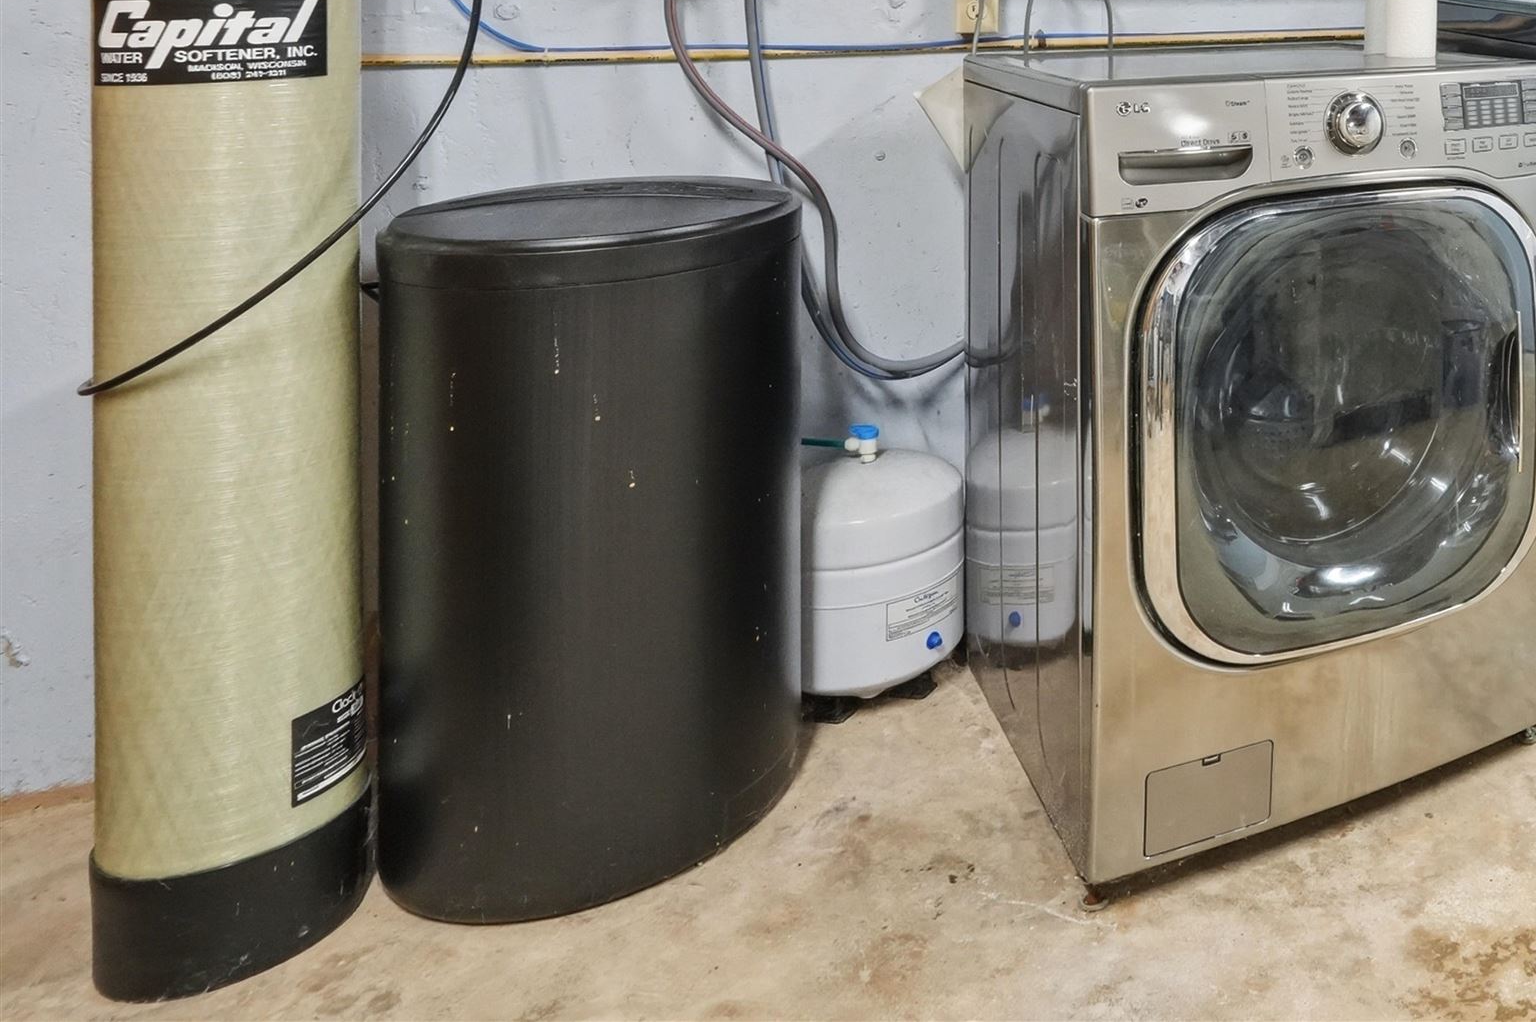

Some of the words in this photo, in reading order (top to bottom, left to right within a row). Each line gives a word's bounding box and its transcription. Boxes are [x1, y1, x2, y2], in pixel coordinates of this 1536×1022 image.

[101, 52, 143, 64] WATER
[174, 47, 281, 63] SOFTENER,
[287, 45, 318, 59] INC.
[246, 60, 307, 70] WISCONSIN
[101, 72, 124, 83] SINCE
[1133, 102, 1151, 114] LG
